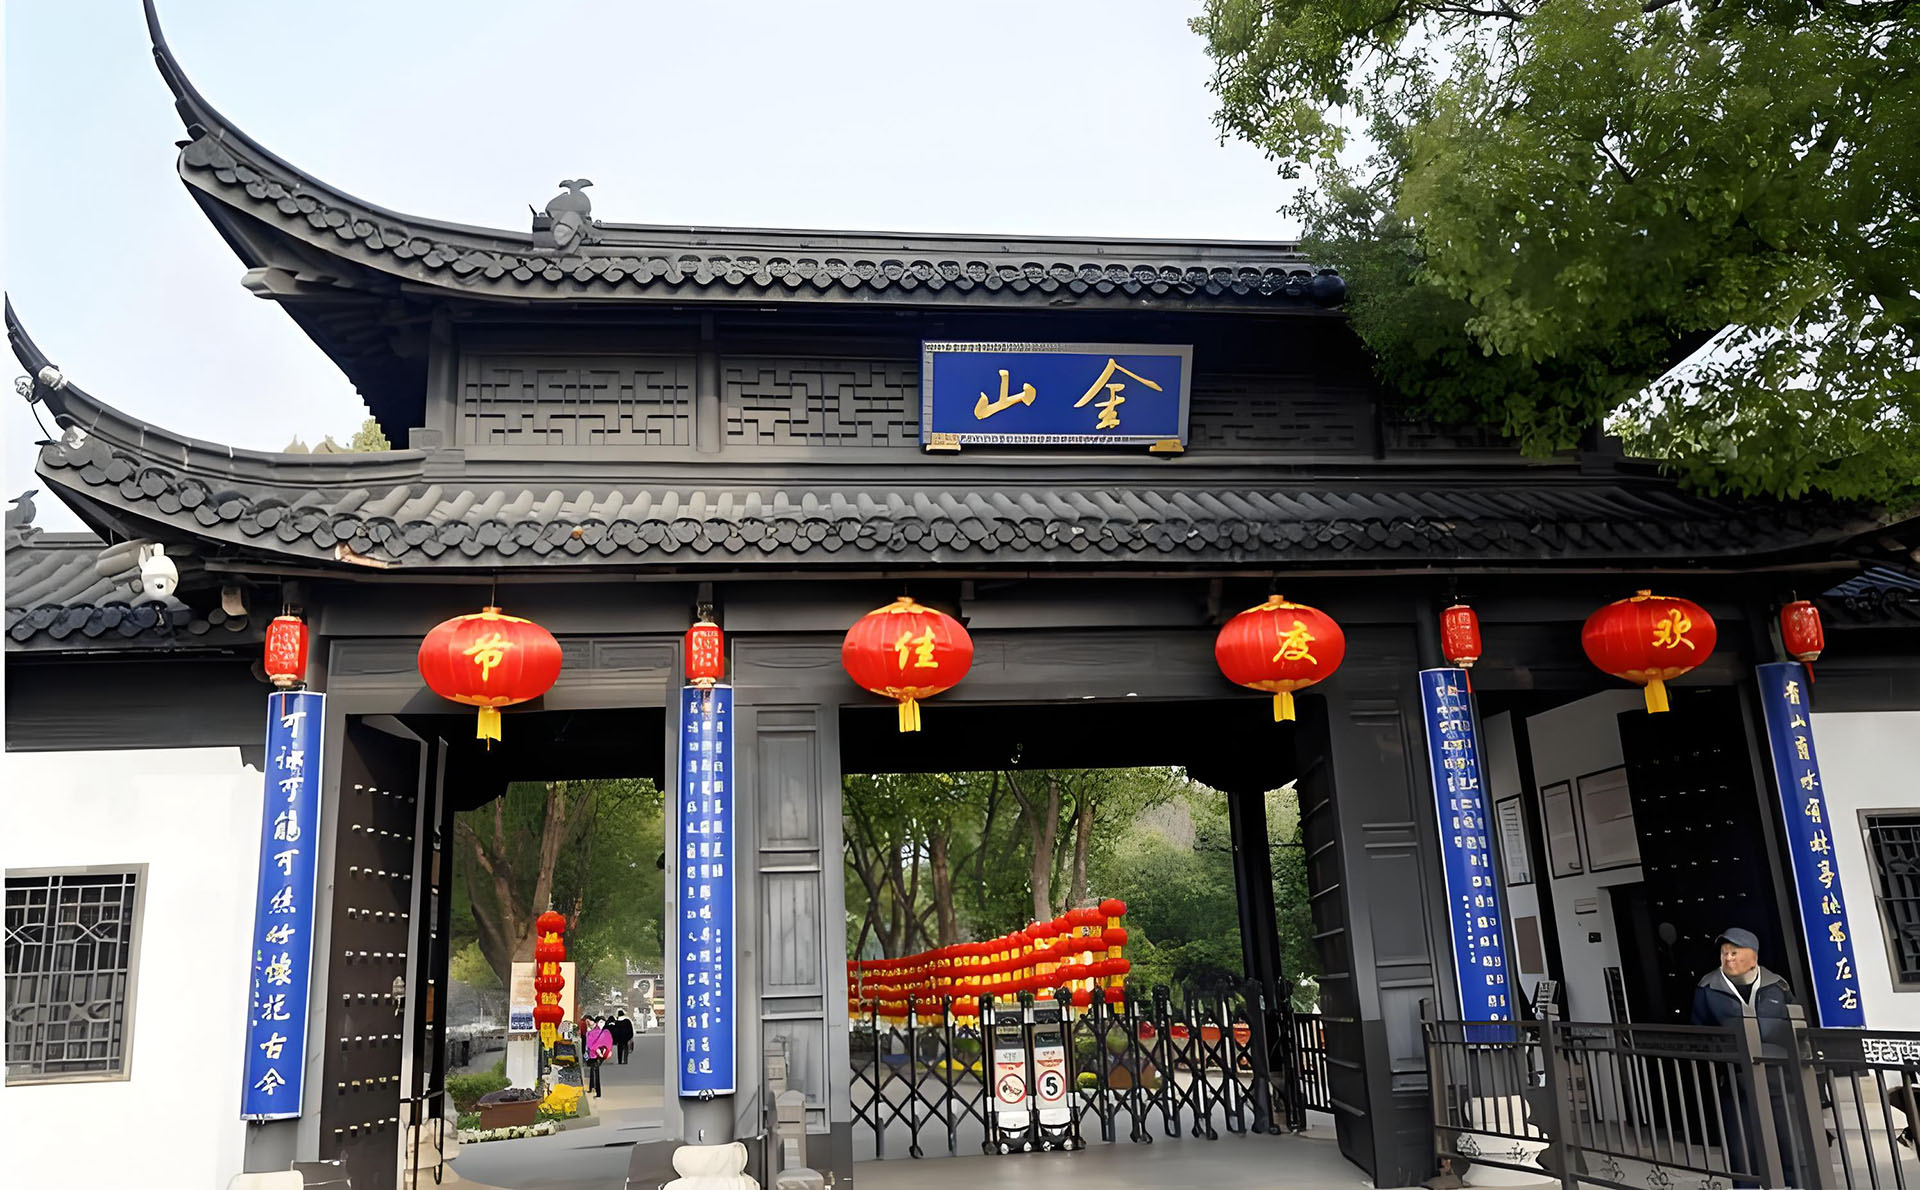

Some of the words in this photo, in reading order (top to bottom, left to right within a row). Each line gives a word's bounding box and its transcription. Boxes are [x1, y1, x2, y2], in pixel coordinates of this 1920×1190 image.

[894, 625, 940, 669] 佳
[1272, 621, 1318, 666] 度
[1652, 608, 1696, 651] 欢
[462, 633, 514, 682] 节
[1045, 1076, 1058, 1096] 5
